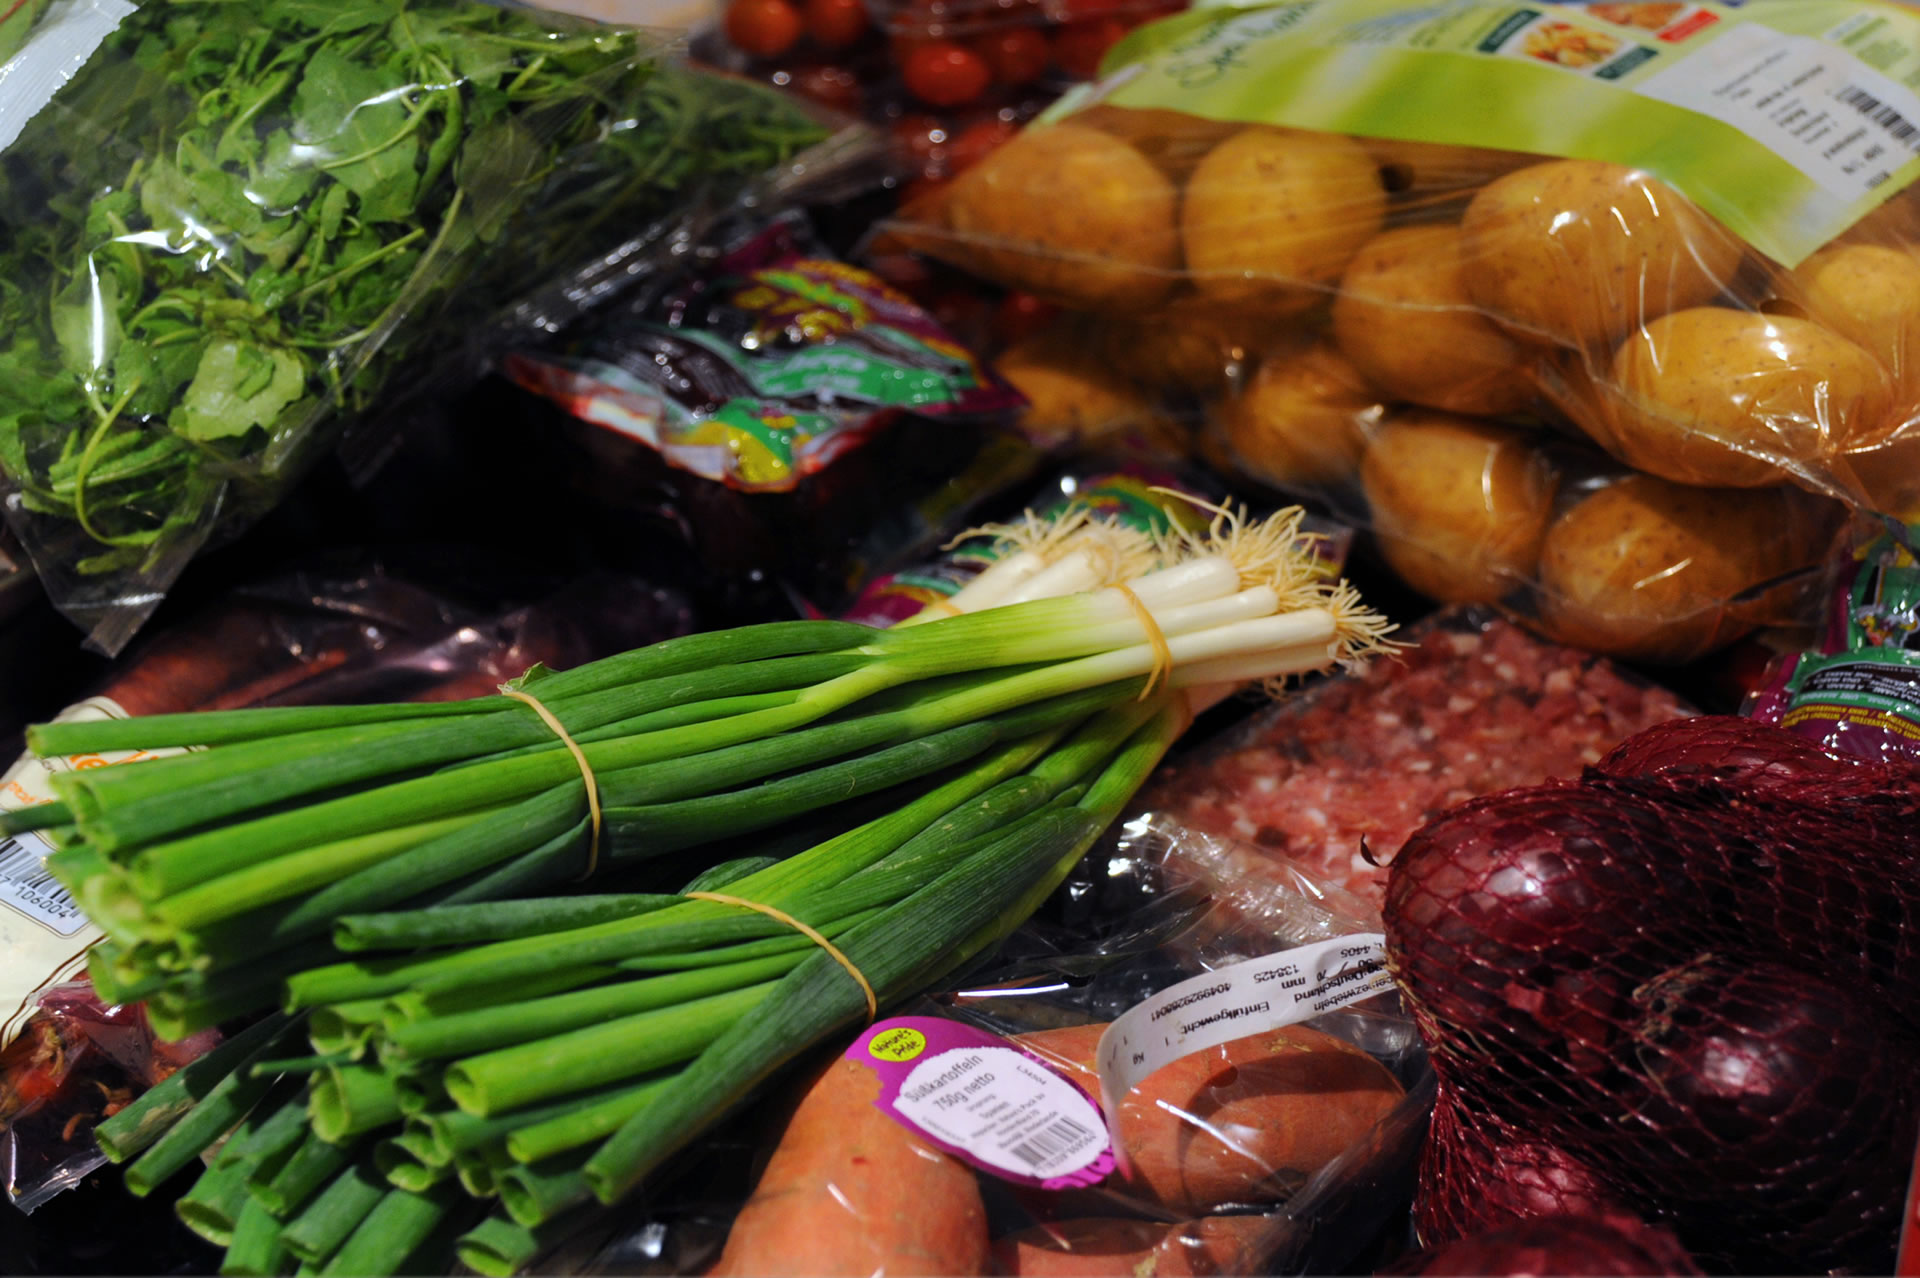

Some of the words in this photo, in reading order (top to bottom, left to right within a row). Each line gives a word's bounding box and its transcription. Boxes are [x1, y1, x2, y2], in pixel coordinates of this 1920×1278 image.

[16, 885, 68, 919] 106004
[1340, 944, 1372, 959] 4405
[1253, 963, 1300, 984] 138425
[1280, 976, 1306, 990] mm
[903, 1054, 984, 1104] Süßkartoffeln
[932, 1089, 969, 1112] 750g
[964, 1070, 996, 1096] netto
